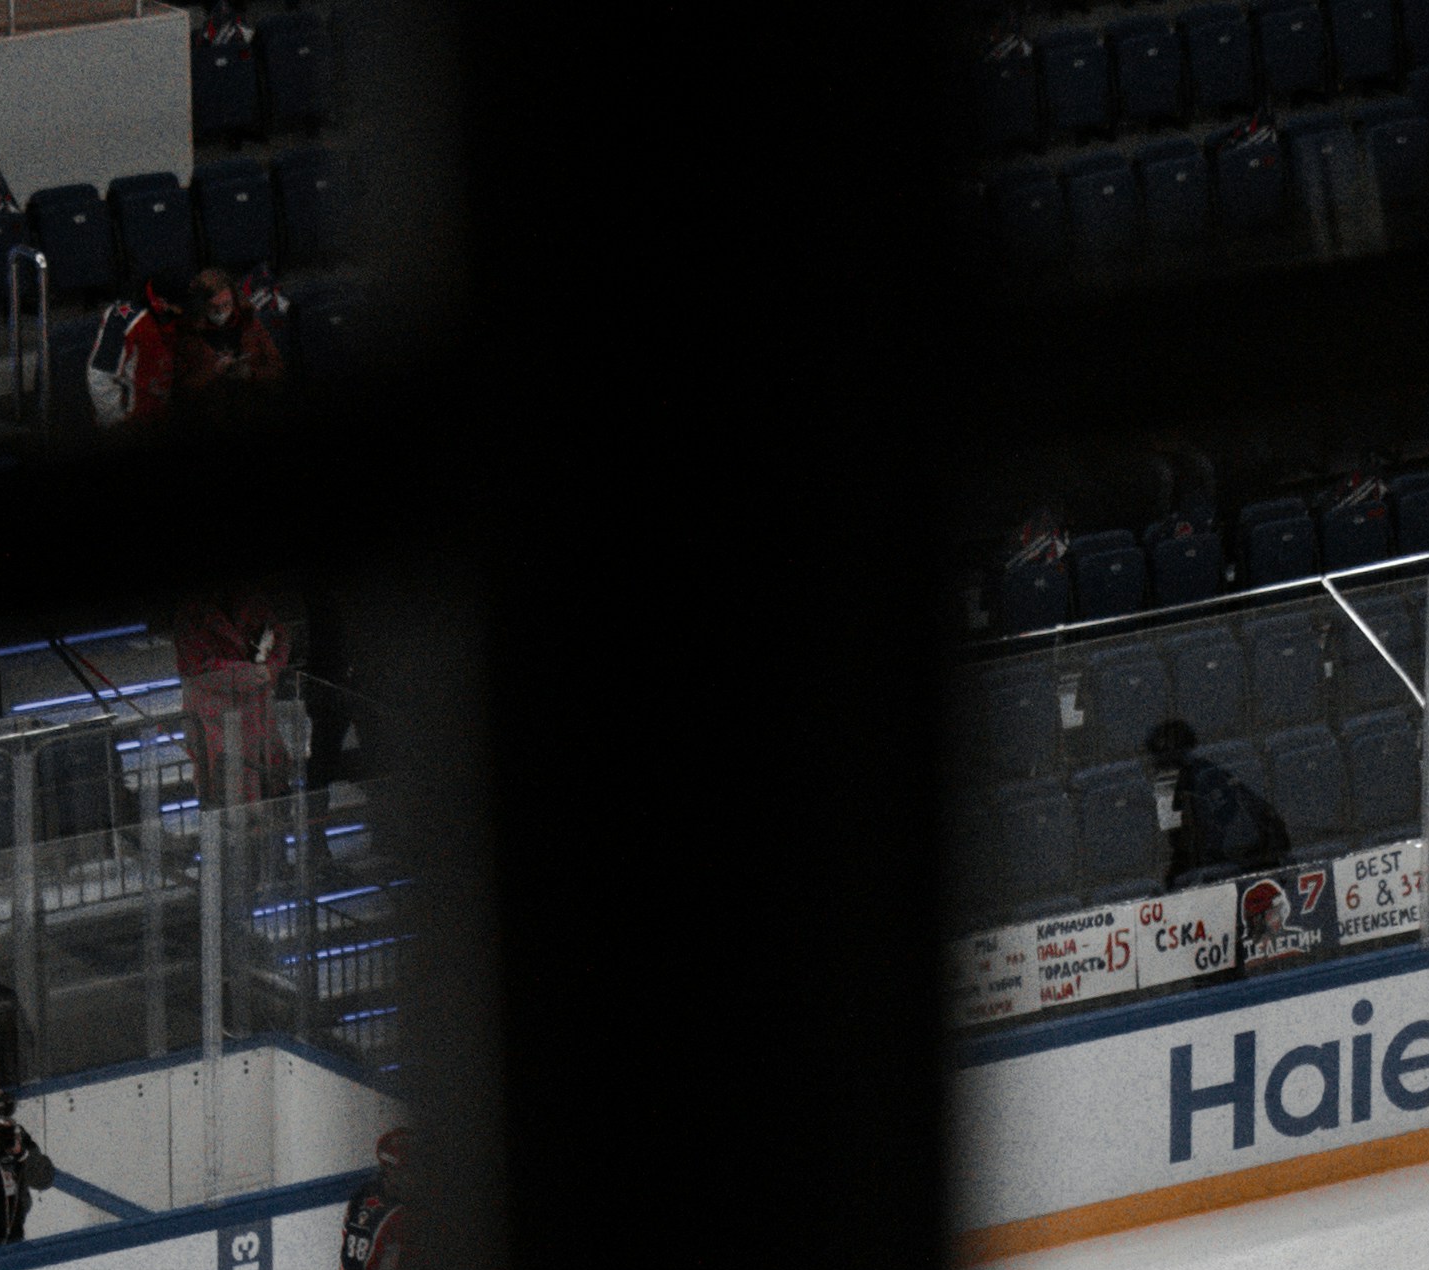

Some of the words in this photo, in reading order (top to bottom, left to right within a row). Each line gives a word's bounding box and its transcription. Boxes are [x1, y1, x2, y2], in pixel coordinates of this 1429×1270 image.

[1355, 850, 1402, 881] BEST
[1297, 868, 1327, 916] 7
[1345, 883, 1361, 910] 6
[1036, 912, 1115, 941] КАРНАУХОВ
[1338, 905, 1419, 937] DEFENSEME
[1104, 928, 1131, 973] 15
[1194, 933, 1230, 971] GO!
